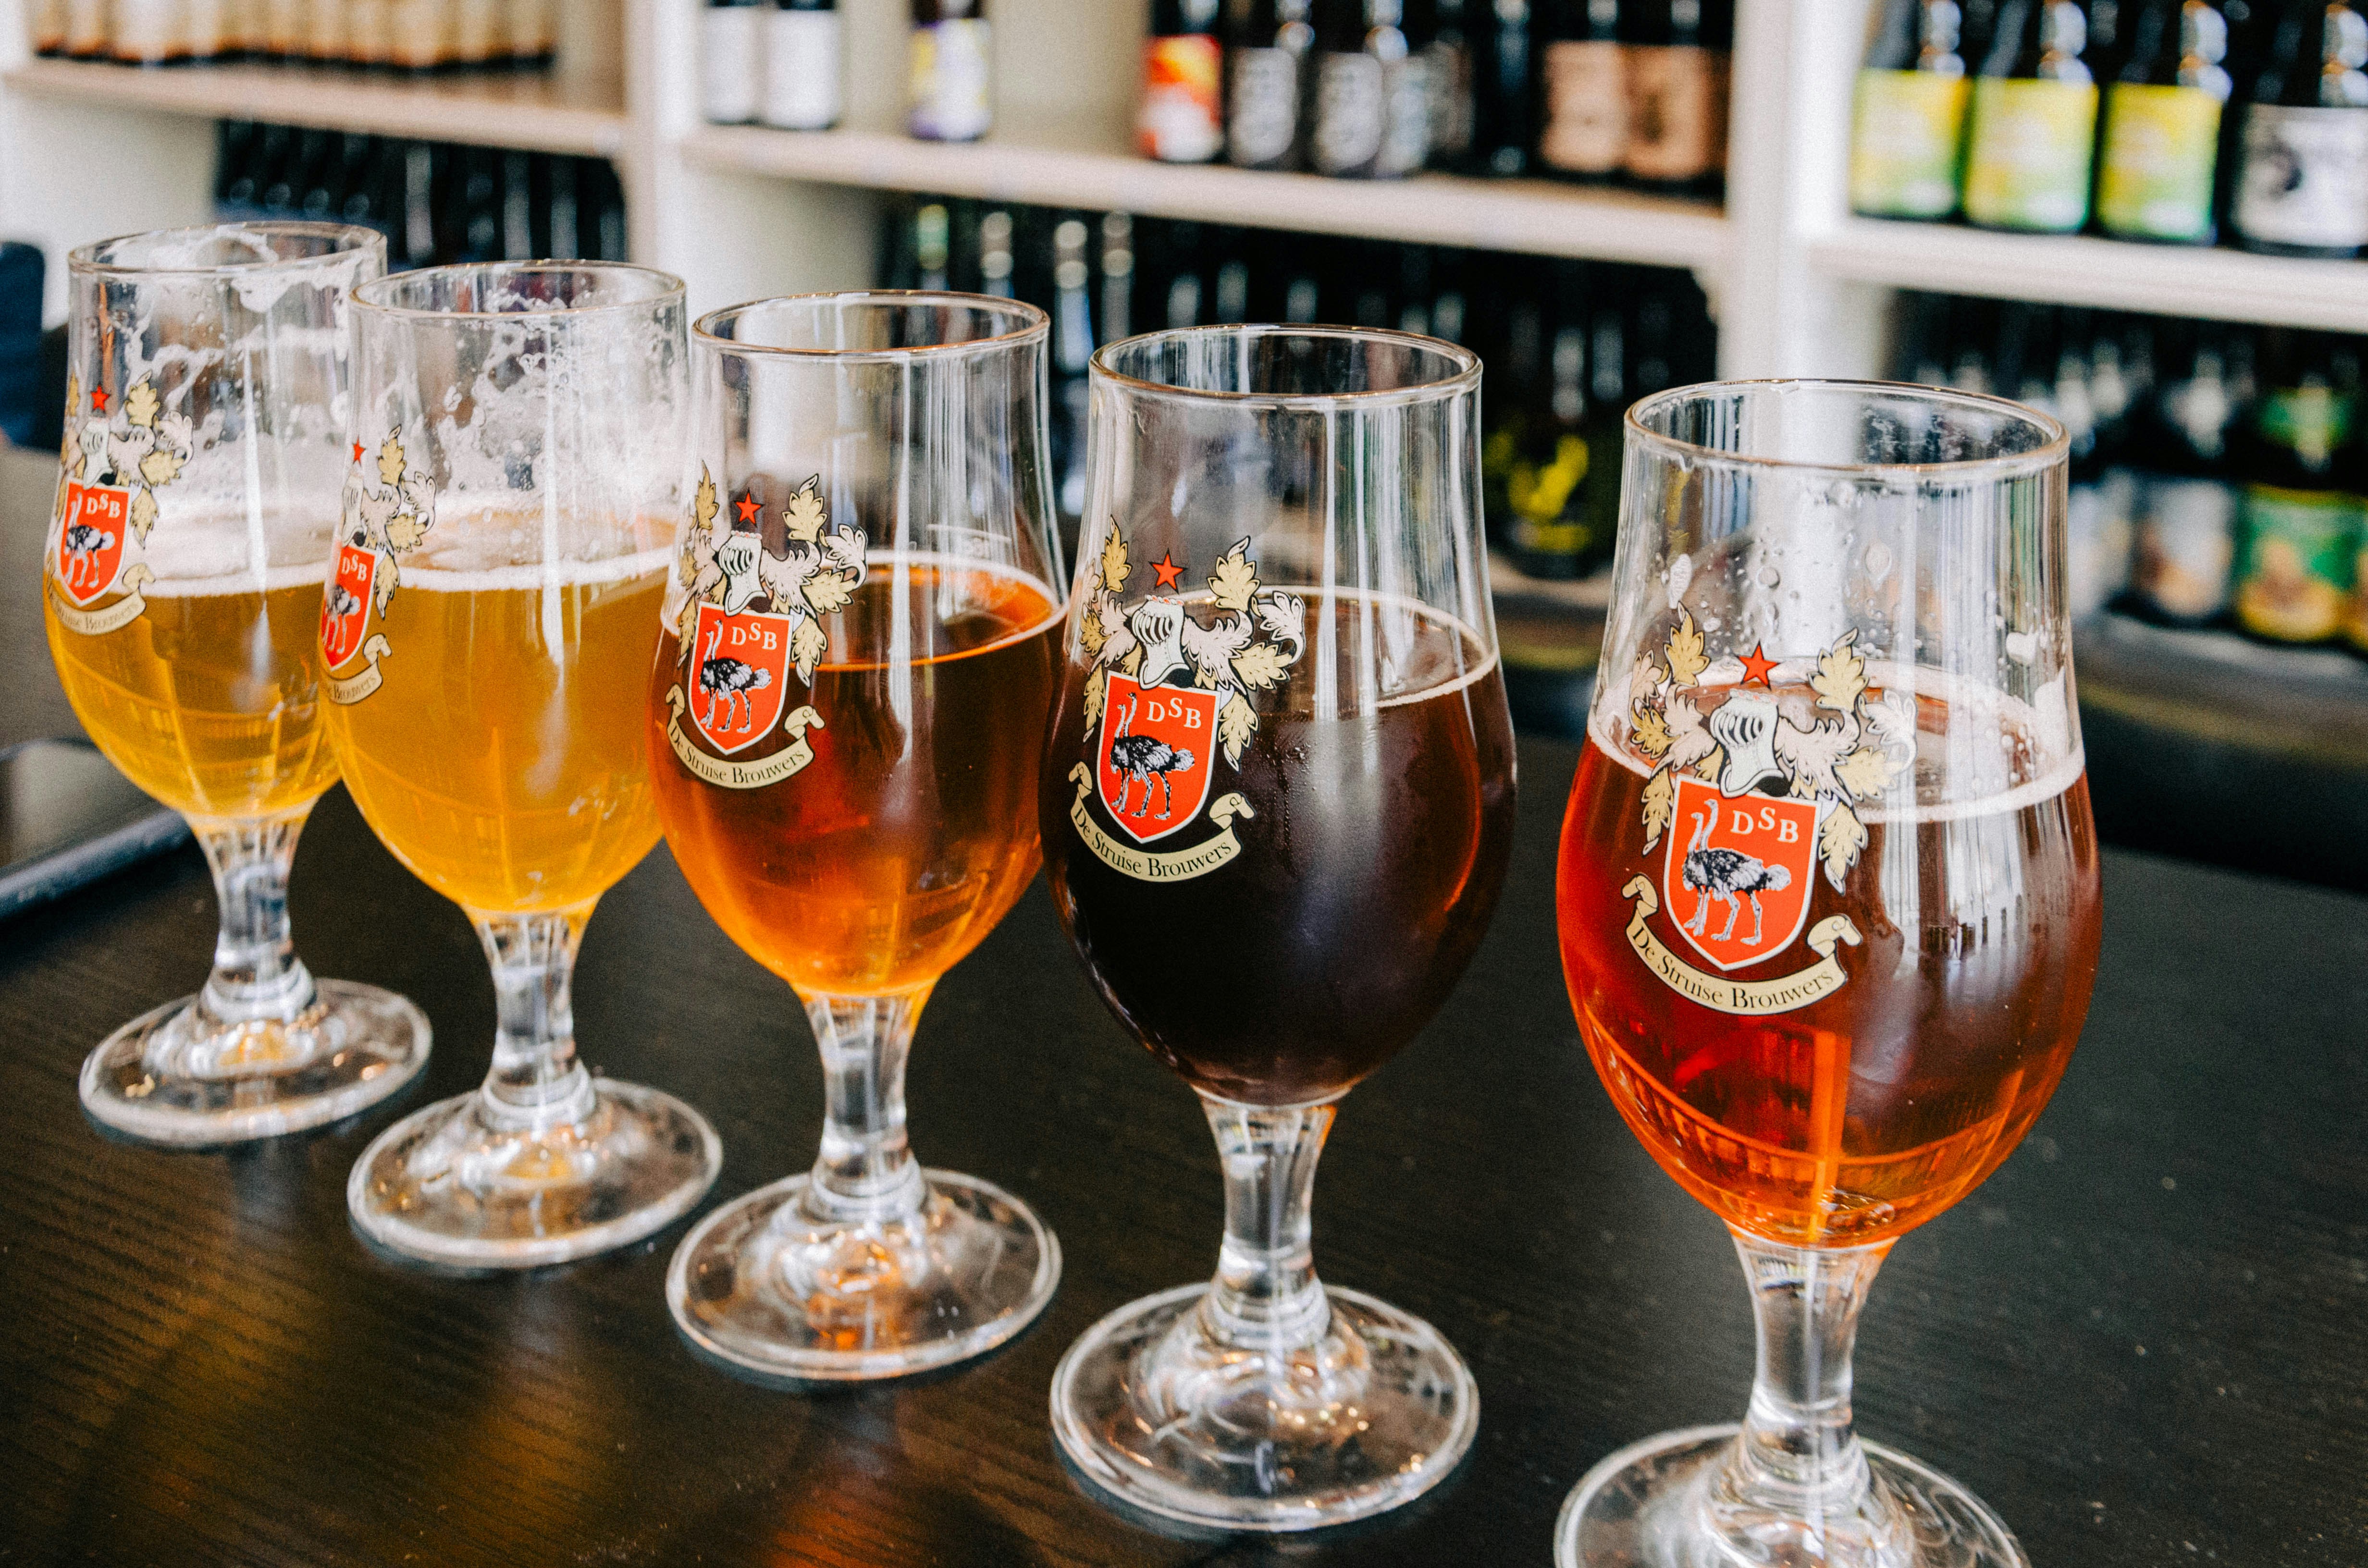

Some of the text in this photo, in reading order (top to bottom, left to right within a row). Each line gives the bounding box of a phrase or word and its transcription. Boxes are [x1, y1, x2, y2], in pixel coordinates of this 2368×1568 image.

[86, 493, 120, 518] DSB
[342, 554, 367, 582] DSB
[730, 623, 777, 650] DSB
[1147, 697, 1201, 729] DSB
[670, 727, 805, 784] De Struise Brouwers
[1074, 807, 1232, 877] De Struise Brouwers
[1730, 806, 1800, 844] DSB
[1632, 926, 1834, 1009] De Struise Brouwers
